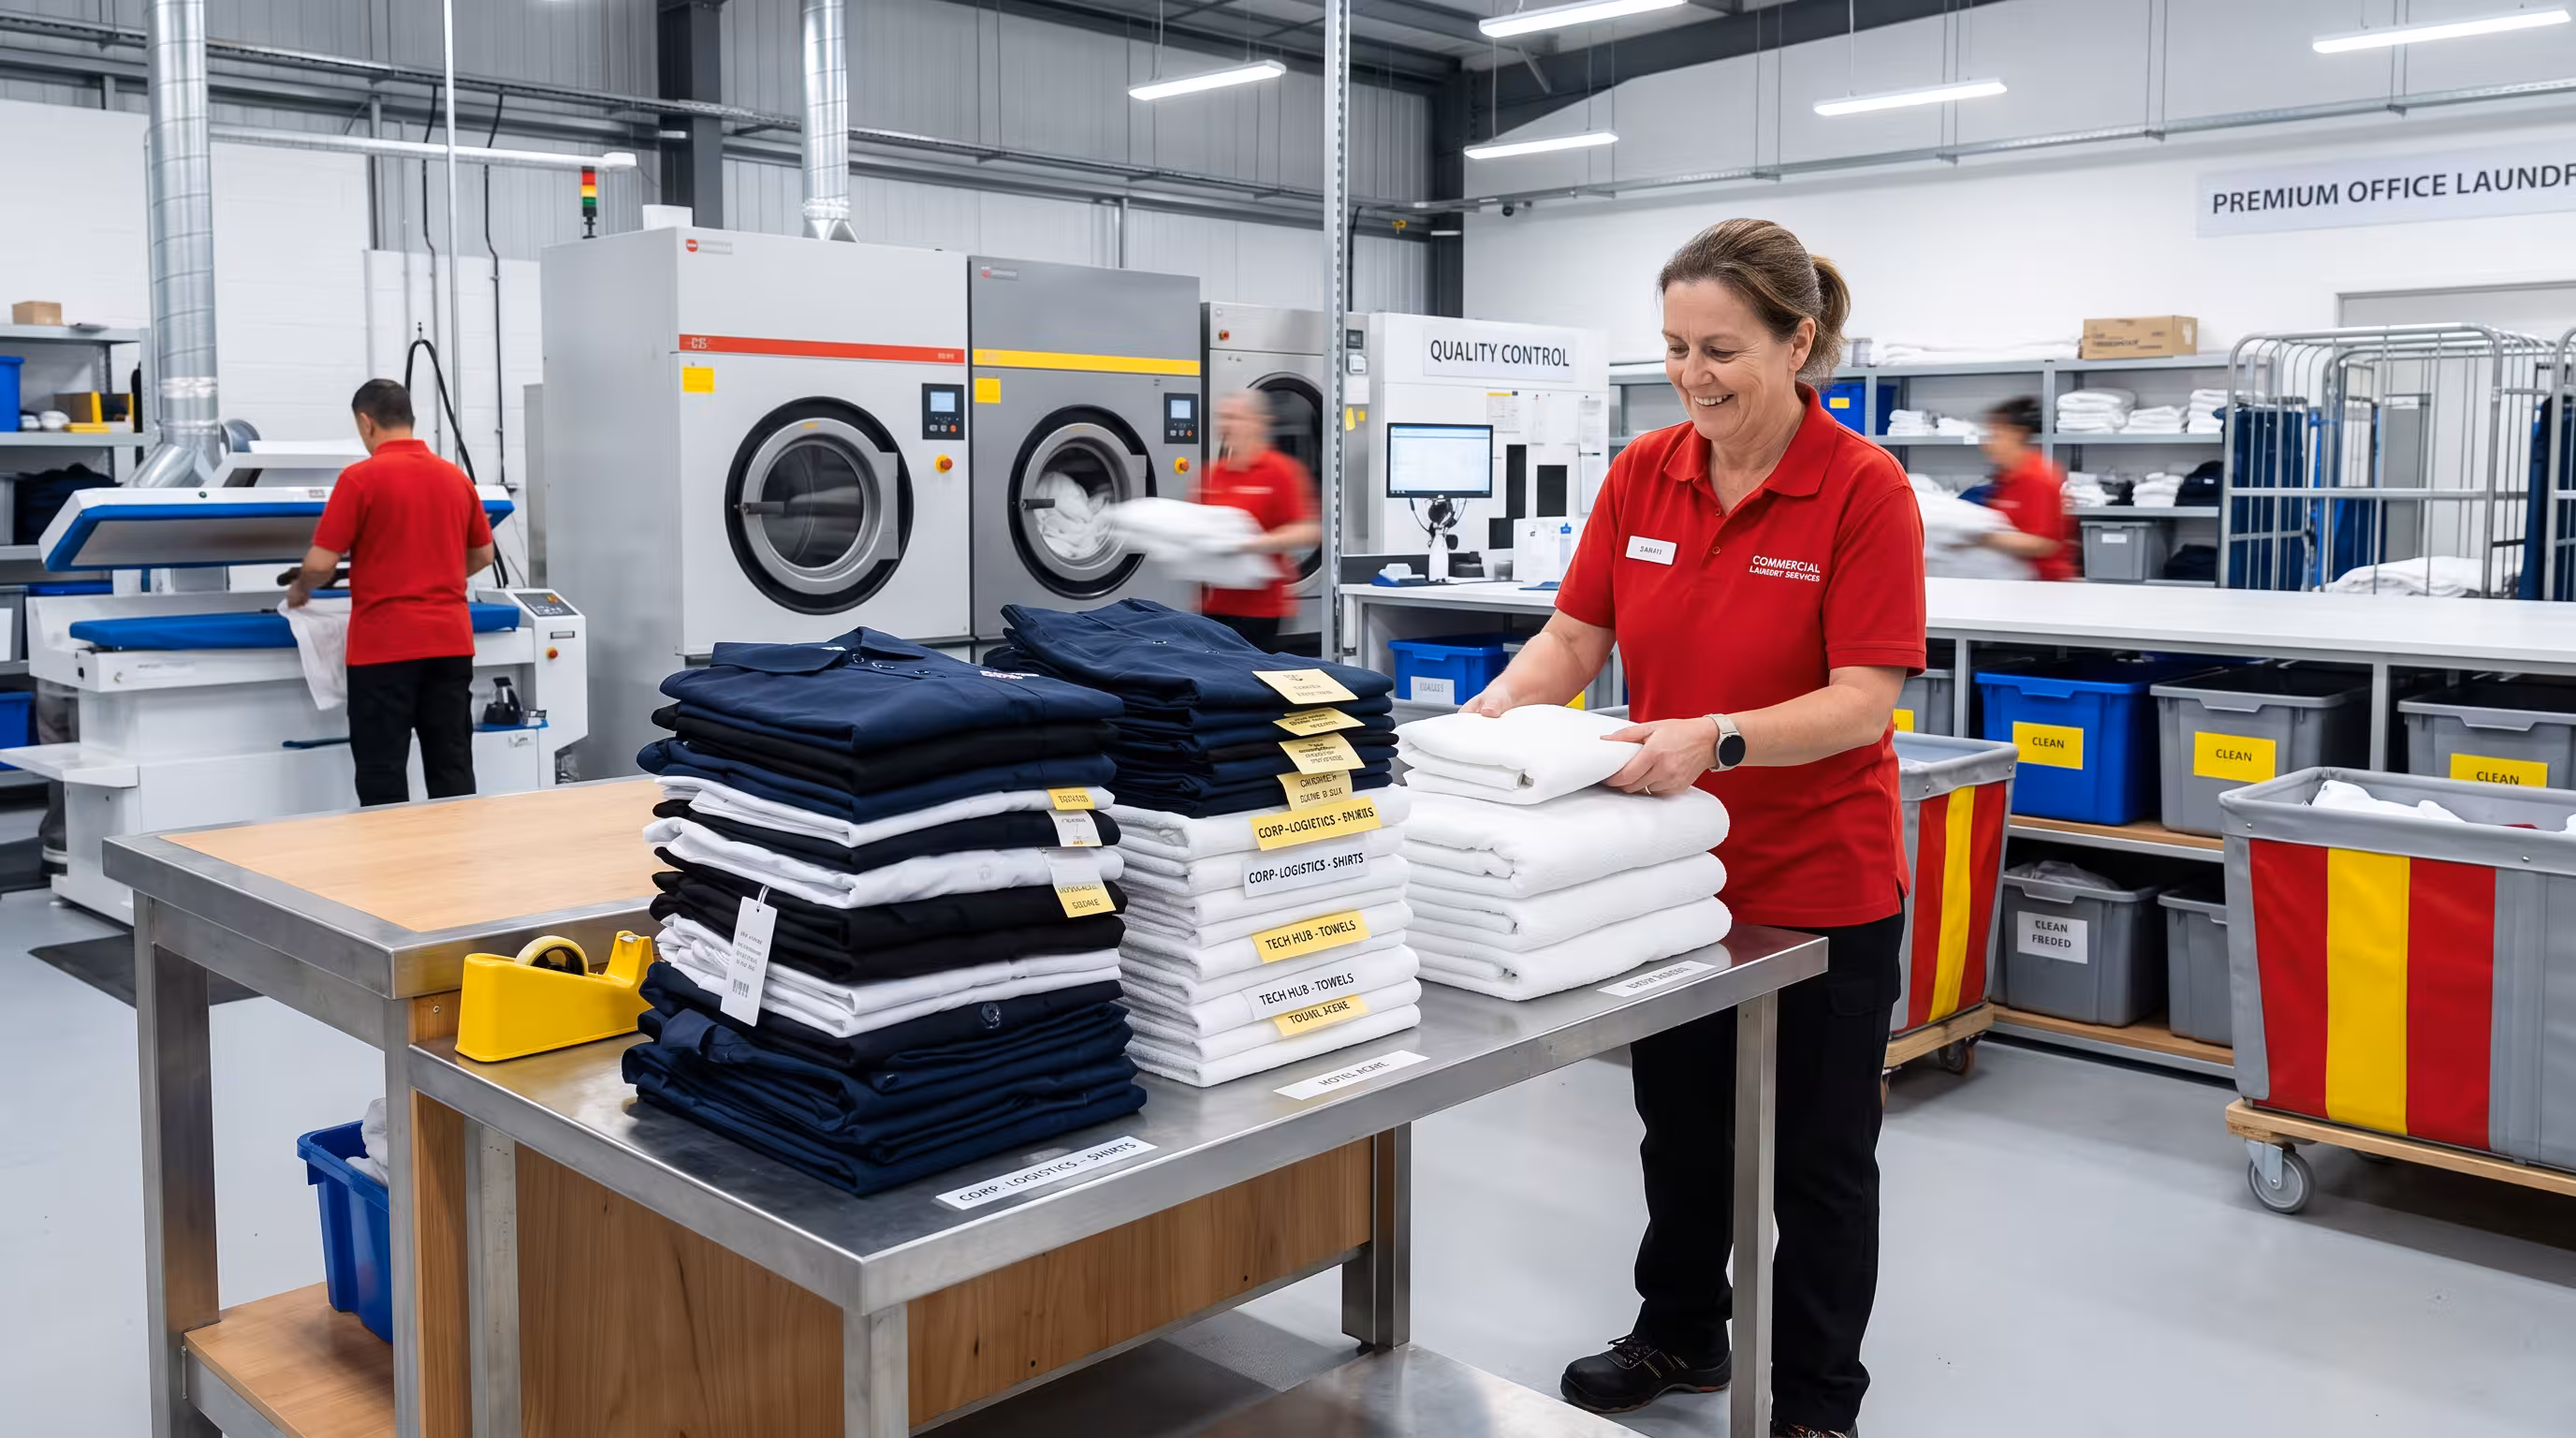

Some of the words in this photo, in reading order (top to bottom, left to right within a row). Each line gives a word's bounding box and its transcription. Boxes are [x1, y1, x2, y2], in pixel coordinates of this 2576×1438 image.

[2213, 183, 2339, 214] PREMIUM
[2348, 174, 2447, 203] OFFICE
[1430, 340, 1498, 362] QUALITY
[1501, 345, 1570, 367] CONTROL
[1752, 555, 1820, 573] COMMERCIAL
[2032, 737, 2065, 749] CLEAN
[2216, 749, 2252, 762] CLEAN
[2477, 771, 2520, 785] CLEAN
[1333, 852, 1364, 869] SHIRTS
[1266, 935, 1292, 950] TECH
[1292, 930, 1313, 945] HUB
[1318, 920, 1356, 937] TOWELS
[2035, 920, 2068, 932] CLEAN
[1259, 990, 1287, 1005] TECH
[1287, 984, 1310, 999] HUB
[1315, 973, 1354, 991] TOWELS
[1005, 1161, 1077, 1187] LOGISTICS
